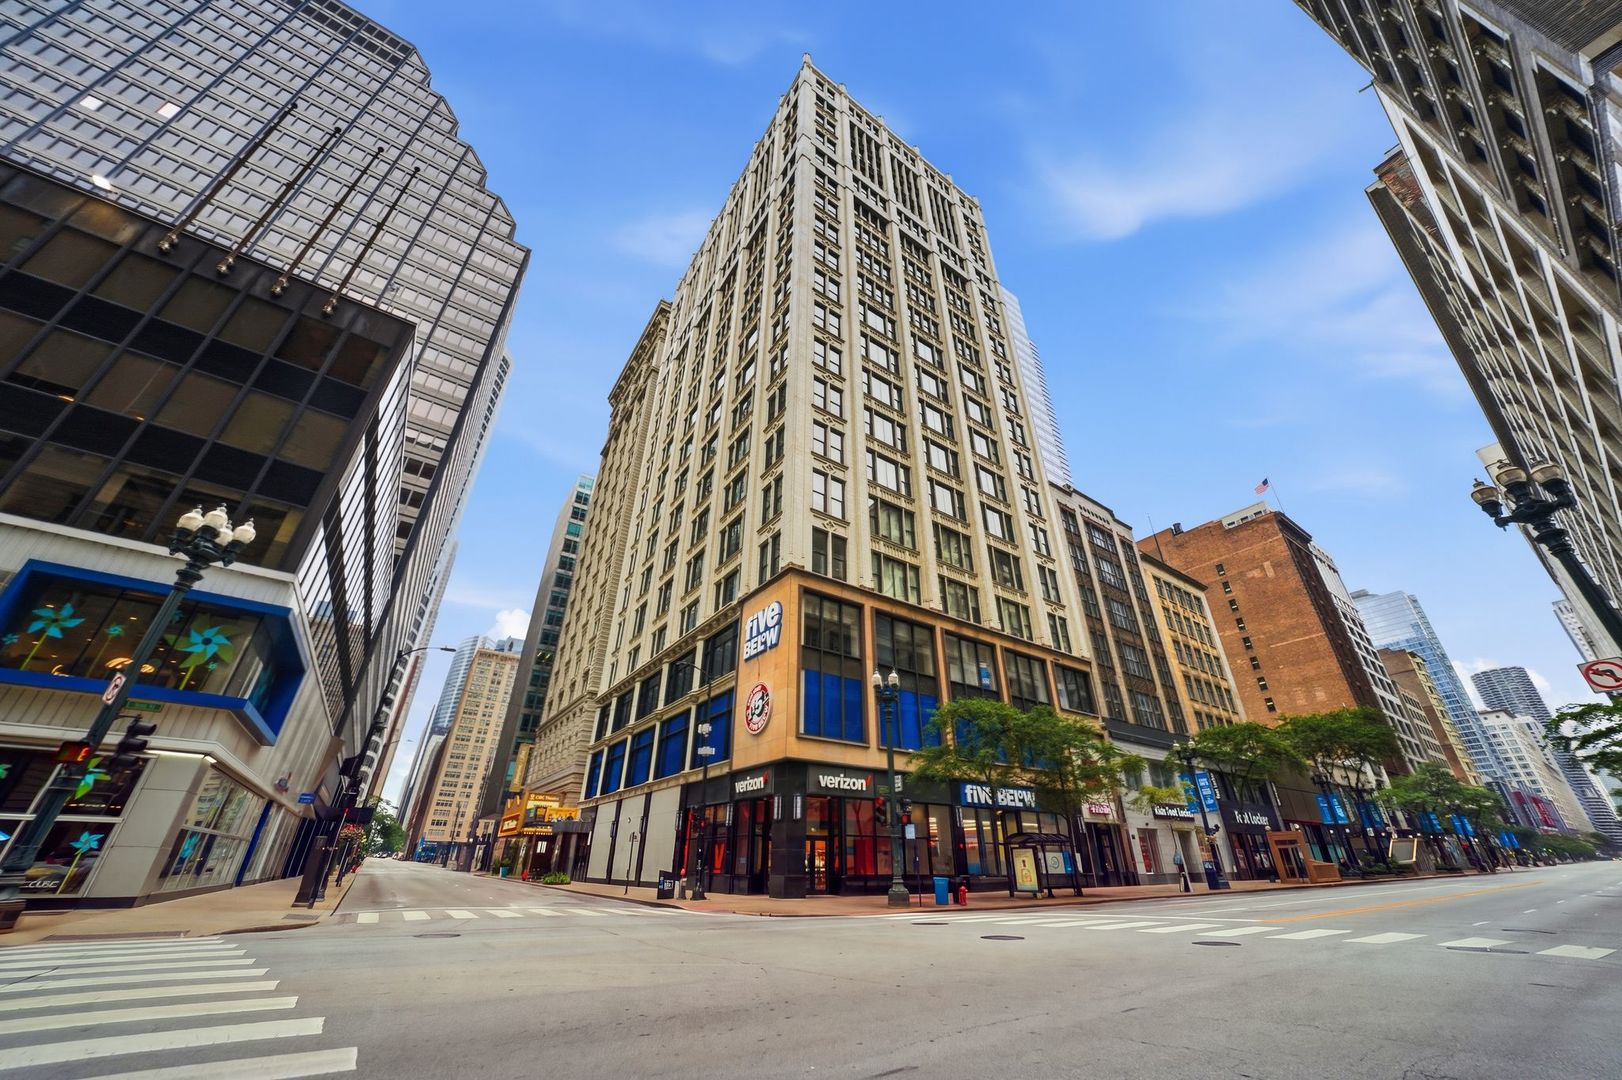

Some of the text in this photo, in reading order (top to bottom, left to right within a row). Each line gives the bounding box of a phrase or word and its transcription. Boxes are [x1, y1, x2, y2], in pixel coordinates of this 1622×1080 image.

[745, 601, 782, 640] five
[735, 776, 764, 793] verizon
[818, 774, 867, 791] verizon
